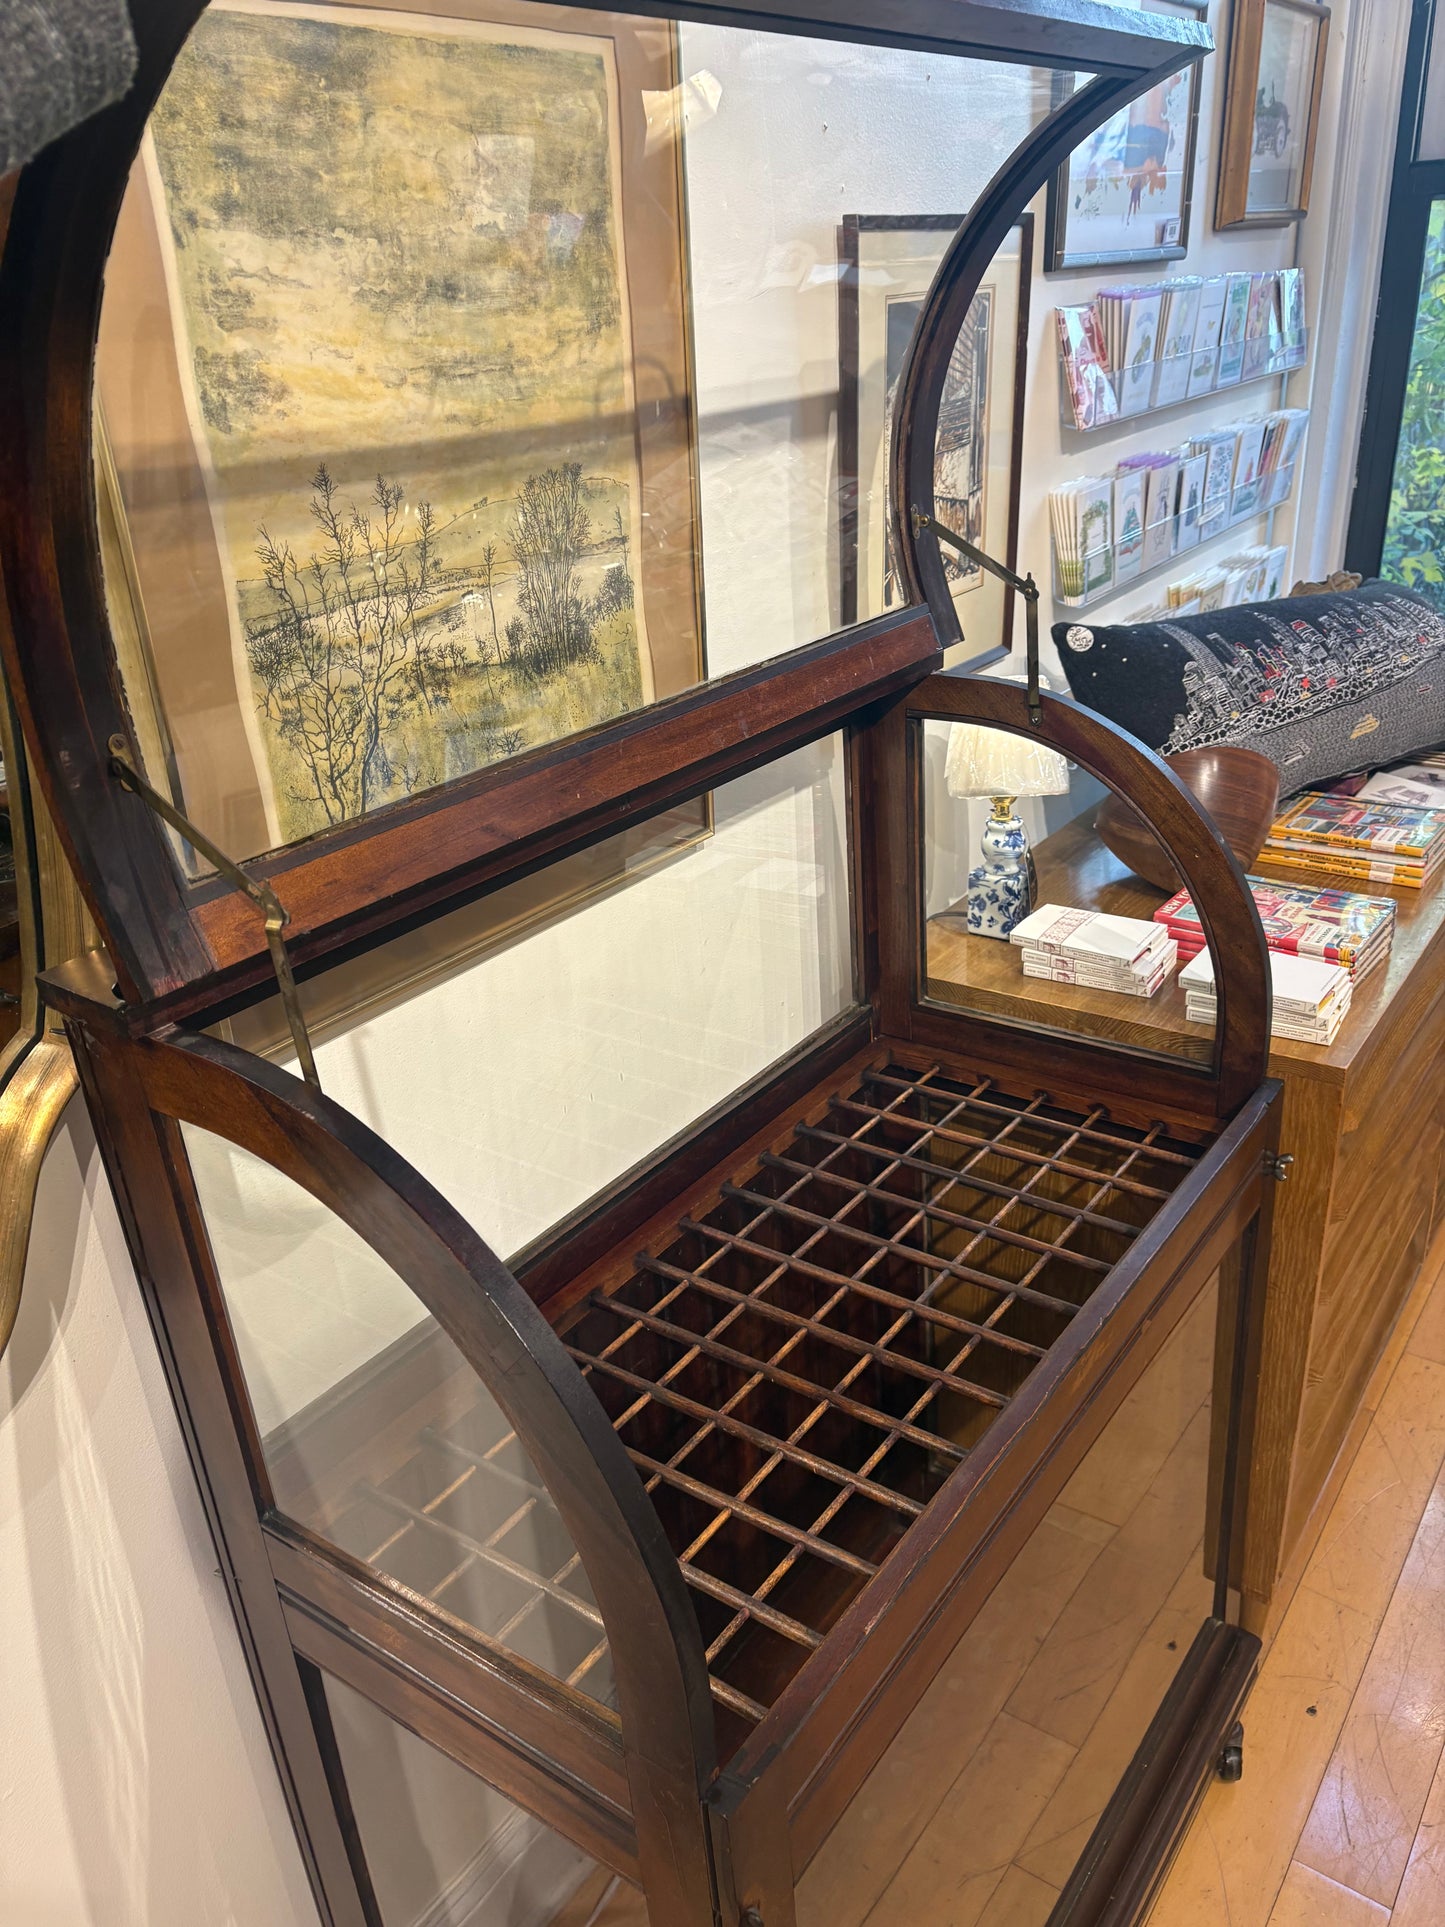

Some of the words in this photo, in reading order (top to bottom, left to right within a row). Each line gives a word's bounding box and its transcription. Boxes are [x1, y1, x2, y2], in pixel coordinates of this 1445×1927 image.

[1306, 833, 1331, 842] NATIONAL
[1333, 837, 1352, 845] PARKS
[1306, 853, 1331, 861] NATIONAL
[1333, 857, 1352, 865] PARKS
[1160, 899, 1182, 914] NEW
